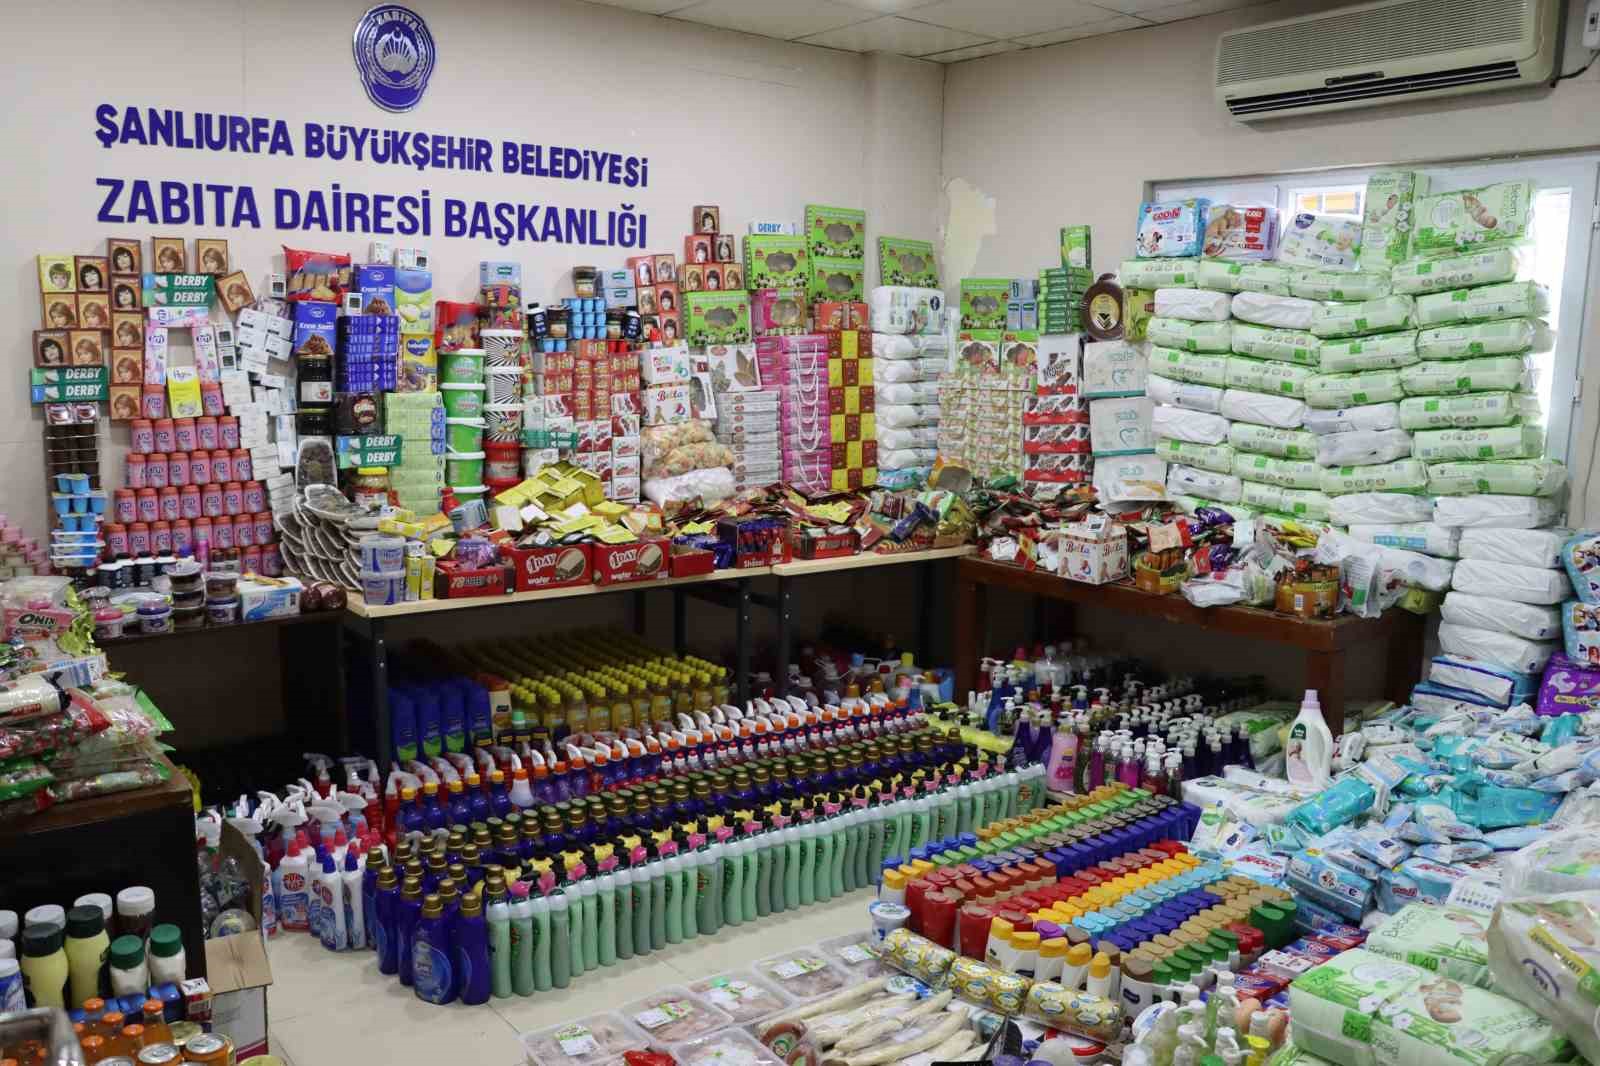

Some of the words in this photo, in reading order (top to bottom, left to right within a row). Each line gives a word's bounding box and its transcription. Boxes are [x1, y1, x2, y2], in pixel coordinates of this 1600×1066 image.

[376, 11, 418, 31] ZABITA
[95, 105, 294, 155] ŞANLIURFA
[304, 123, 493, 171] BÜYÜKŞEHİR
[502, 142, 649, 188] BELEDİYESİ
[95, 179, 261, 228] ZABITA
[274, 183, 432, 236] DAİRESİ
[444, 199, 648, 249] BAŞKANLIĞI
[173, 275, 208, 288] DERBY
[172, 291, 208, 303] DERBY
[65, 367, 102, 380] DERBY
[65, 384, 102, 397] DERBY
[366, 436, 397, 448] DERBY
[367, 452, 397, 464] DERBY
[527, 576, 550, 586] wafer
